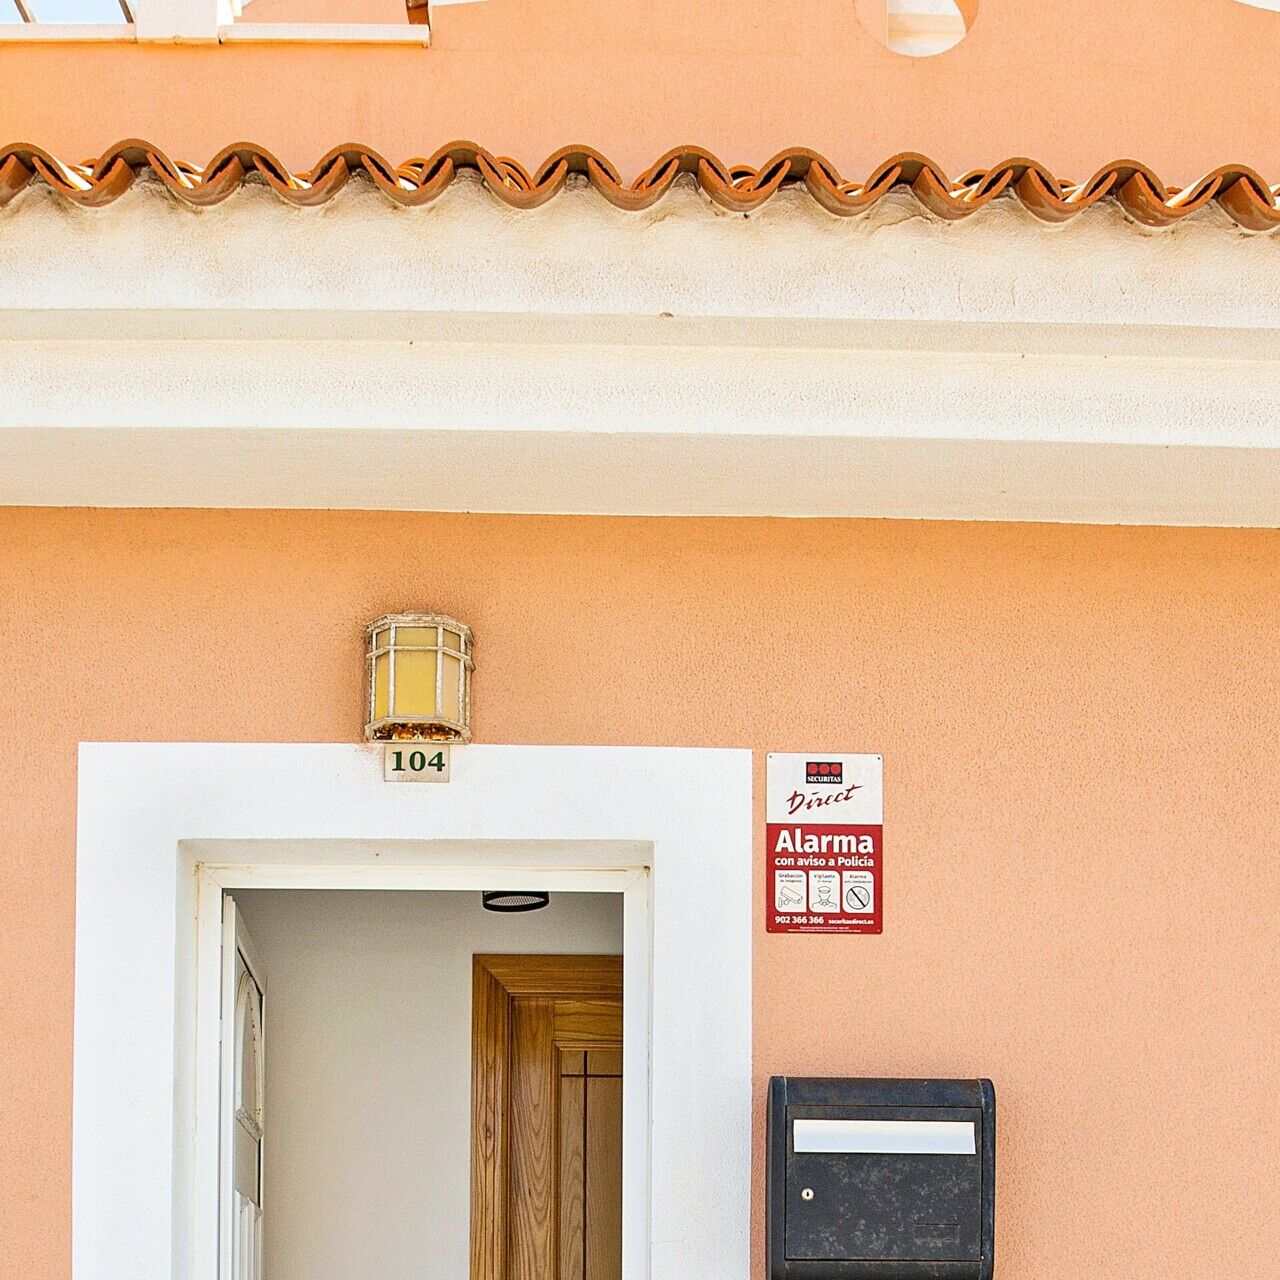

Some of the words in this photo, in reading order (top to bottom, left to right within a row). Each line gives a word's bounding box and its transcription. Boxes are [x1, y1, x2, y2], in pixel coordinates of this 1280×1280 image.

[392, 751, 445, 771] 104
[786, 784, 863, 815] Direct
[774, 827, 874, 854] Alarma
[774, 857, 795, 866] con
[797, 855, 826, 867] aviso
[828, 858, 835, 867] a
[838, 855, 874, 867] Policía
[774, 916, 791, 924] 902
[791, 916, 808, 924] 366
[808, 916, 824, 924] 366
